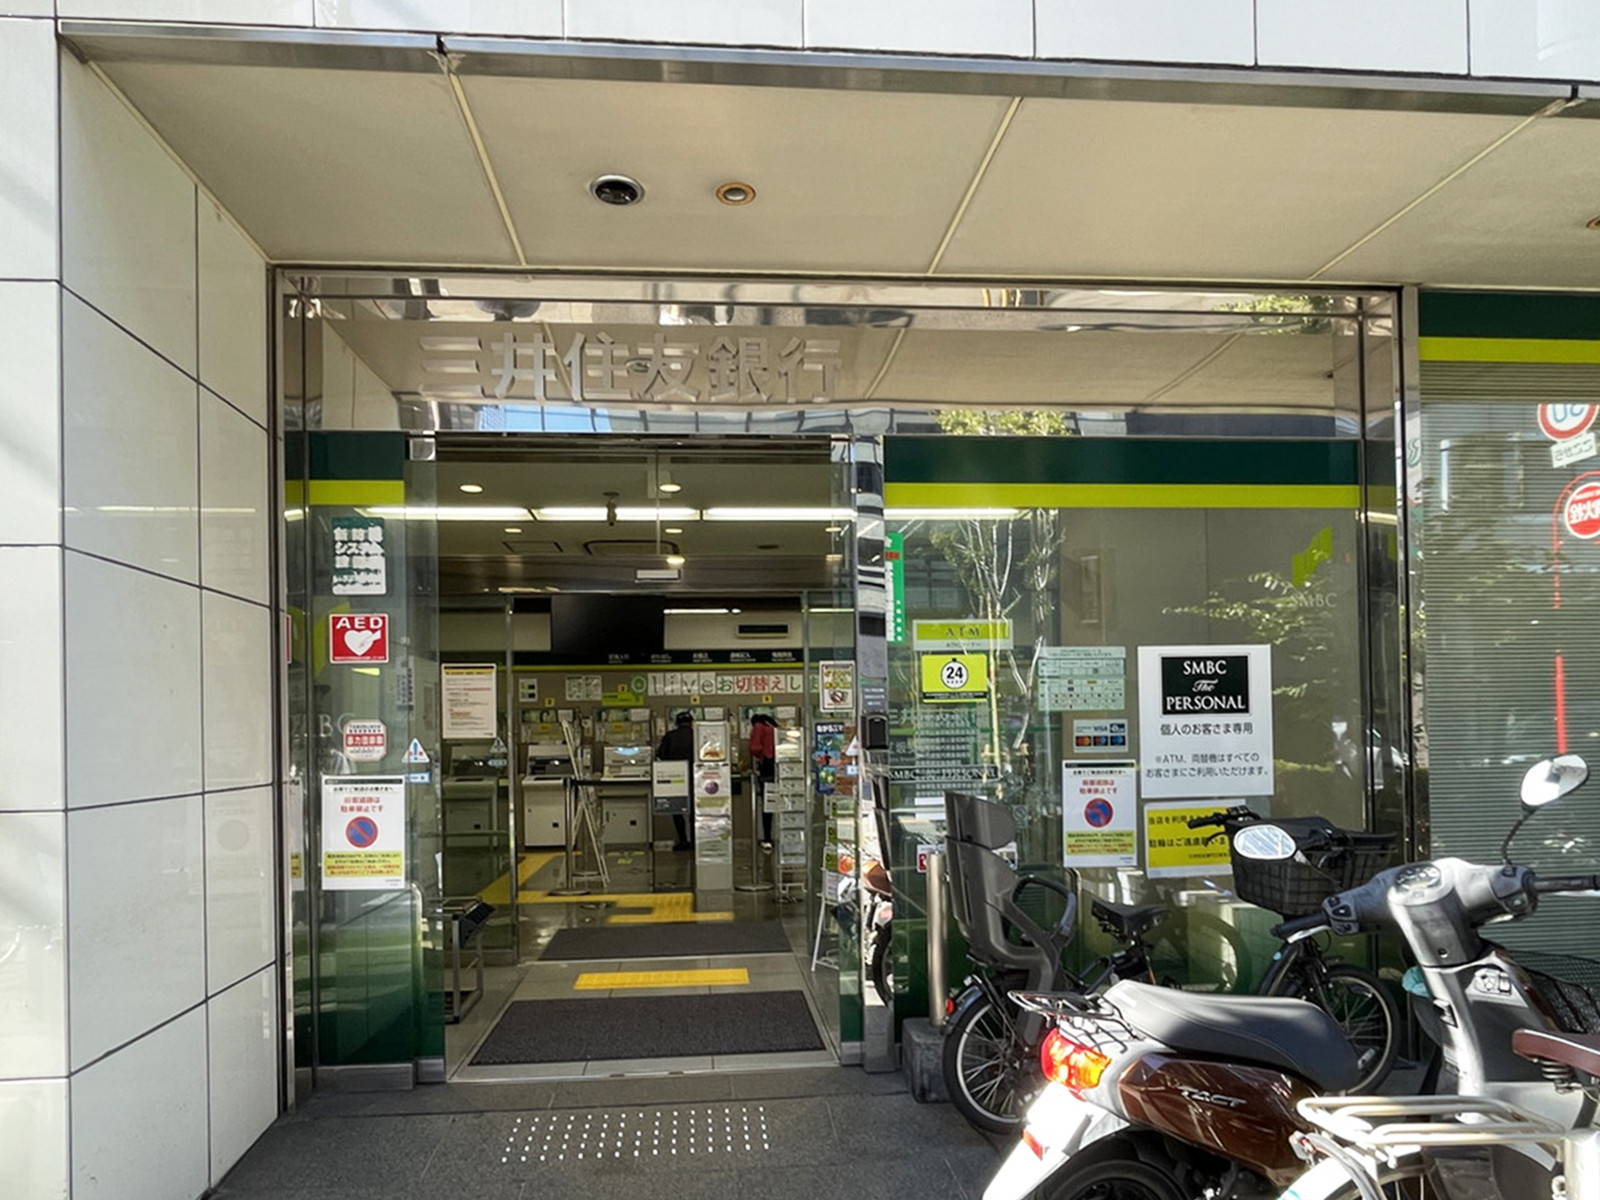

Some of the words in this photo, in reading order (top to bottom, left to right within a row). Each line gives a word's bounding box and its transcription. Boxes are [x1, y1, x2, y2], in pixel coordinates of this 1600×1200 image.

[419, 332, 842, 402] 三井住友銀行
[336, 616, 383, 629] AED
[946, 627, 980, 637] ATM
[946, 666, 964, 680] 24
[1183, 660, 1227, 675] SMBC
[1192, 679, 1219, 692] The
[1166, 695, 1246, 711] PERSONAL
[1161, 722, 1254, 736] 個人のお客さま専用
[1146, 766, 1269, 778] お客さまにご利用いただけます。
